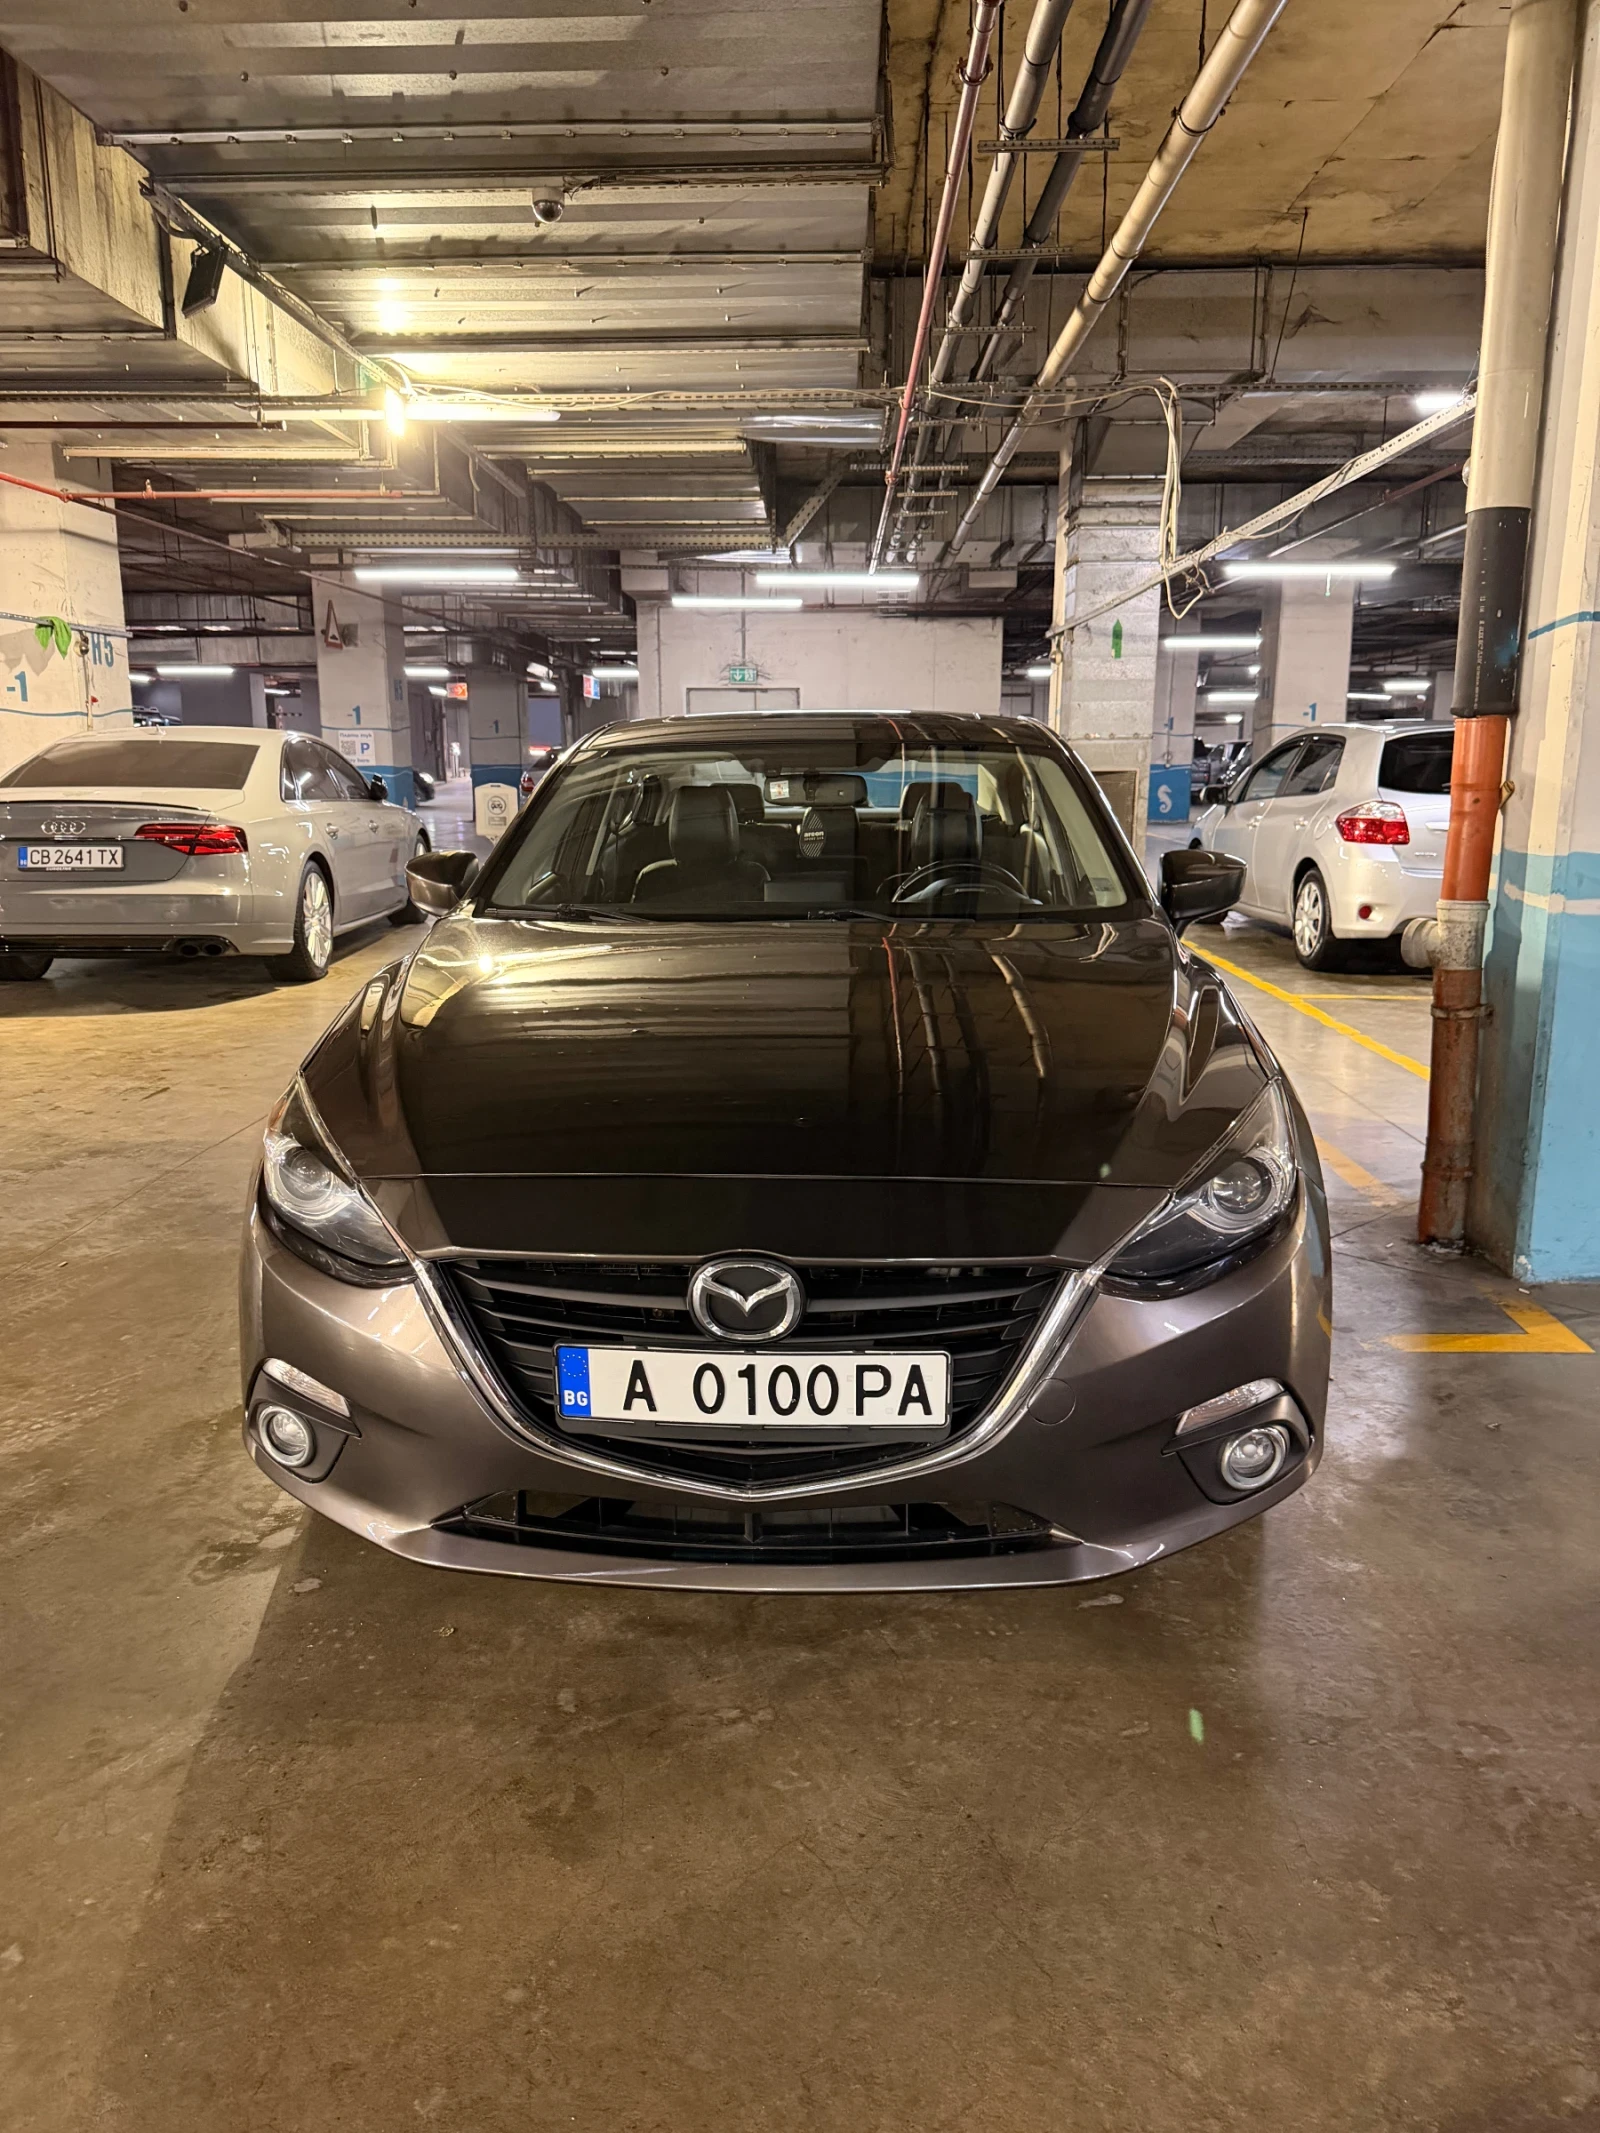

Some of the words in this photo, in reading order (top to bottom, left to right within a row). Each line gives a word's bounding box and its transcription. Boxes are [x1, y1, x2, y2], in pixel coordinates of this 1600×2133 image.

[6, 671, 28, 702] -1
[347, 705, 361, 725] -1
[1302, 703, 1317, 721] -1
[360, 743, 370, 754] P
[30, 849, 51, 865] CB
[54, 849, 92, 865] 2641
[97, 849, 118, 865] TX
[622, 1359, 657, 1412] A
[564, 1389, 588, 1407] BG
